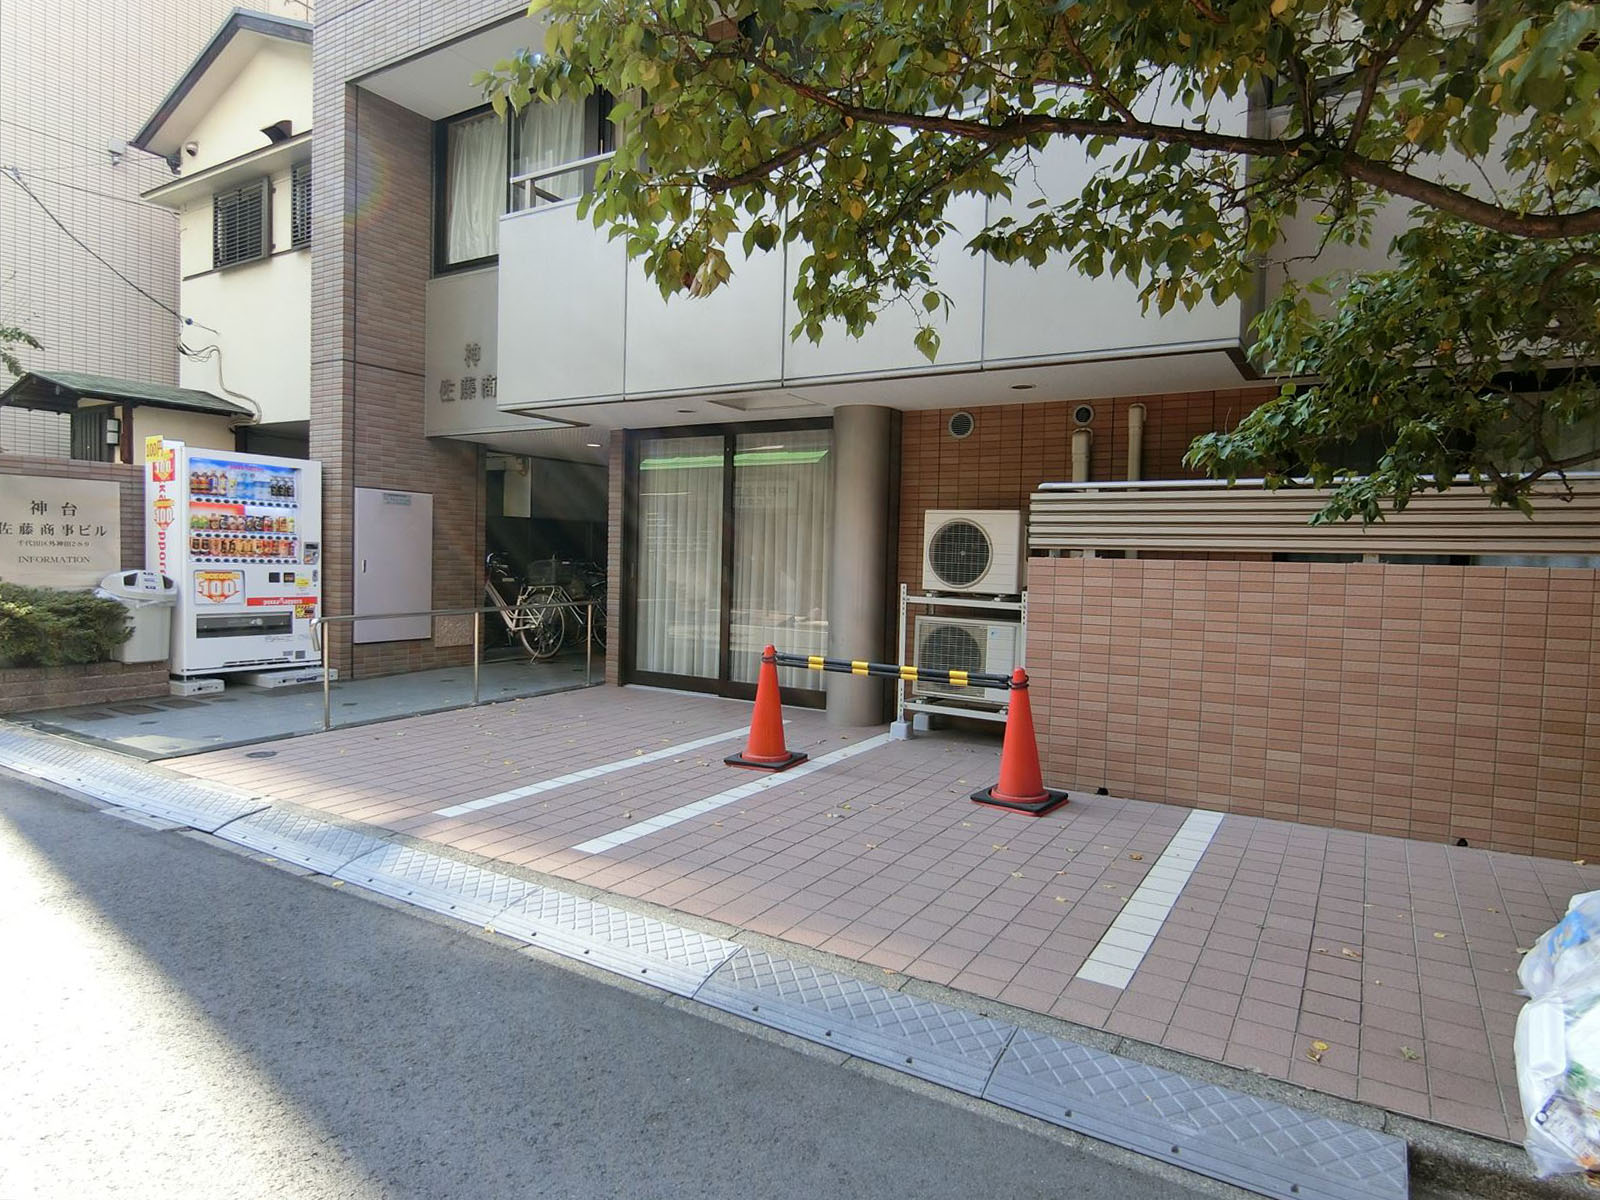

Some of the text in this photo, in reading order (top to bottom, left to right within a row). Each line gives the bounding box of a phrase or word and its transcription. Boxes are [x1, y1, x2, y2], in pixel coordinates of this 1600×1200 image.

[0, 521, 108, 537] 佐藤商事ビル
[18, 555, 91, 564] INFORMATION
[198, 579, 237, 598] 100
